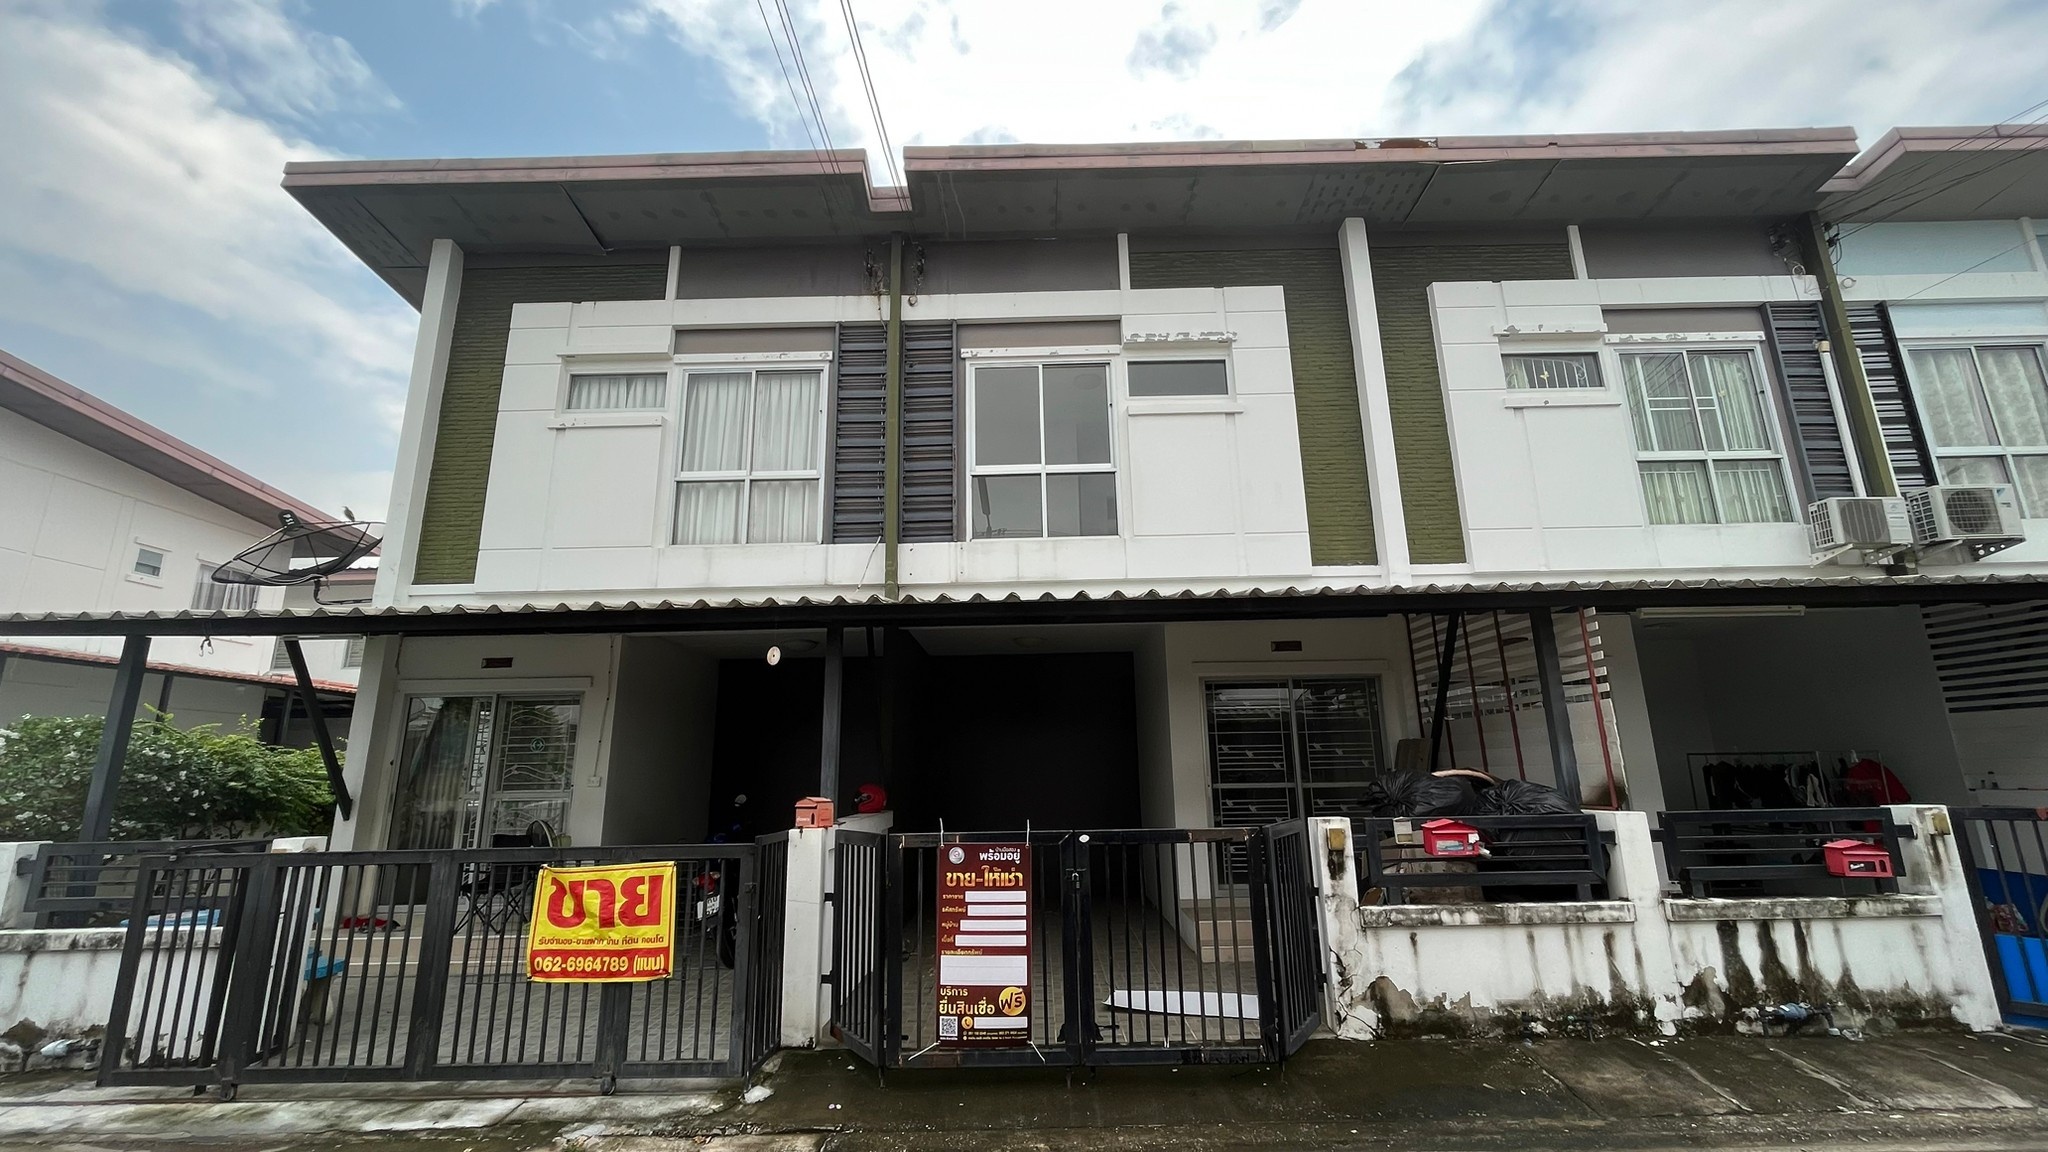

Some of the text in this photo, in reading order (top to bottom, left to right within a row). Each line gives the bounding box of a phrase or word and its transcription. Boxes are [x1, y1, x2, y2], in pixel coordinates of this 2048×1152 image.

[979, 848, 1020, 864] พร้อมอยู่
[946, 865, 1023, 887] ขาย-ให้เช่า
[547, 875, 665, 929] ขาย
[621, 935, 639, 945] ที่ดิน
[641, 933, 664, 944] คอนโด
[534, 953, 665, 975] 062-6964789 (แนน)
[940, 986, 969, 996] บริการ
[1000, 988, 1024, 1010] ฟรี
[939, 996, 995, 1015] ยื่นสินเชื่อ
